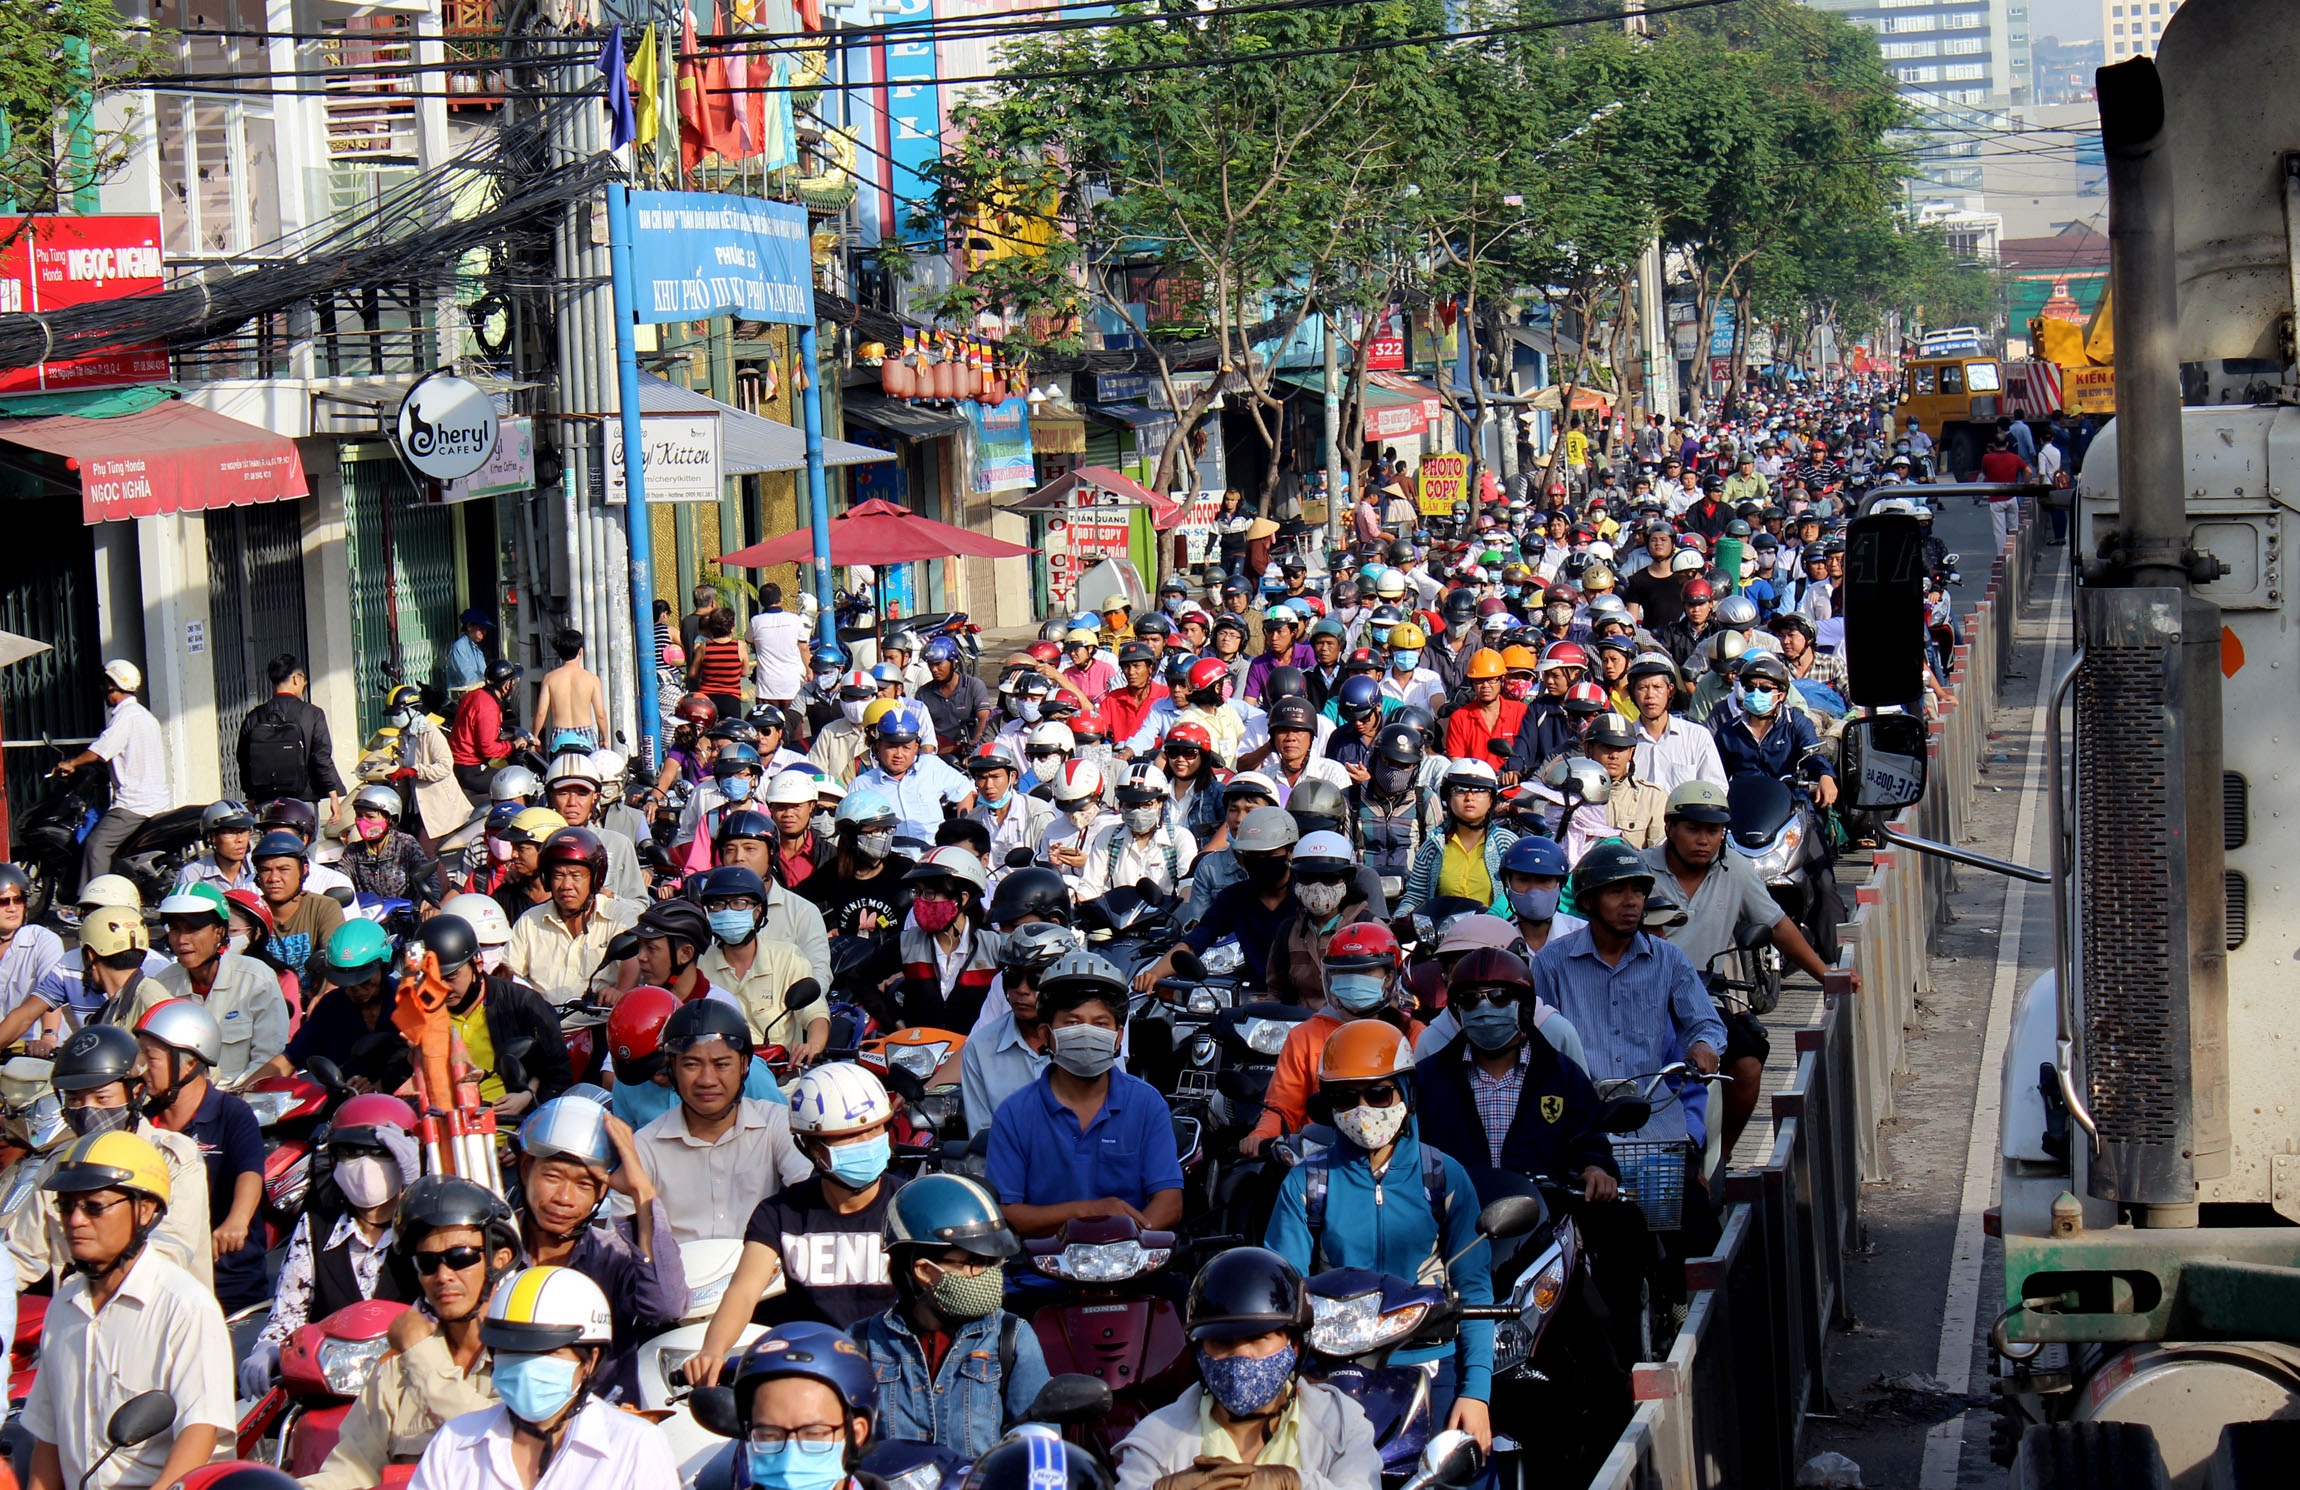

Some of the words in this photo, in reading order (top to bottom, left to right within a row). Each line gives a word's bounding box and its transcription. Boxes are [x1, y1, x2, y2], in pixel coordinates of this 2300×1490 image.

[36, 248, 49, 266] Phụ
[50, 248, 66, 265] Tùng
[747, 249, 756, 269] 13
[42, 267, 63, 281] Honda
[68, 248, 116, 288] NGỌC
[652, 279, 679, 312] KHU
[682, 265, 710, 311] PHỐ
[785, 275, 806, 314] HÓA
[1375, 343, 1402, 356] 322
[2076, 370, 2106, 384] KIẾN
[438, 445, 469, 455] CAFE
[656, 441, 712, 466] Kitten
[93, 462, 106, 477] Phụ
[107, 461, 124, 476] Tùng
[124, 459, 145, 473] Honda
[503, 461, 518, 472] Coffee
[1422, 457, 1463, 477] PHOTO
[91, 482, 120, 504] NGỌC
[122, 475, 152, 499] NGHĨA
[1426, 480, 1458, 498] COPY
[861, 1052, 884, 1063] REPSOL
[1082, 1304, 1128, 1313] HONDA
[1329, 1369, 1364, 1378] HONDA
